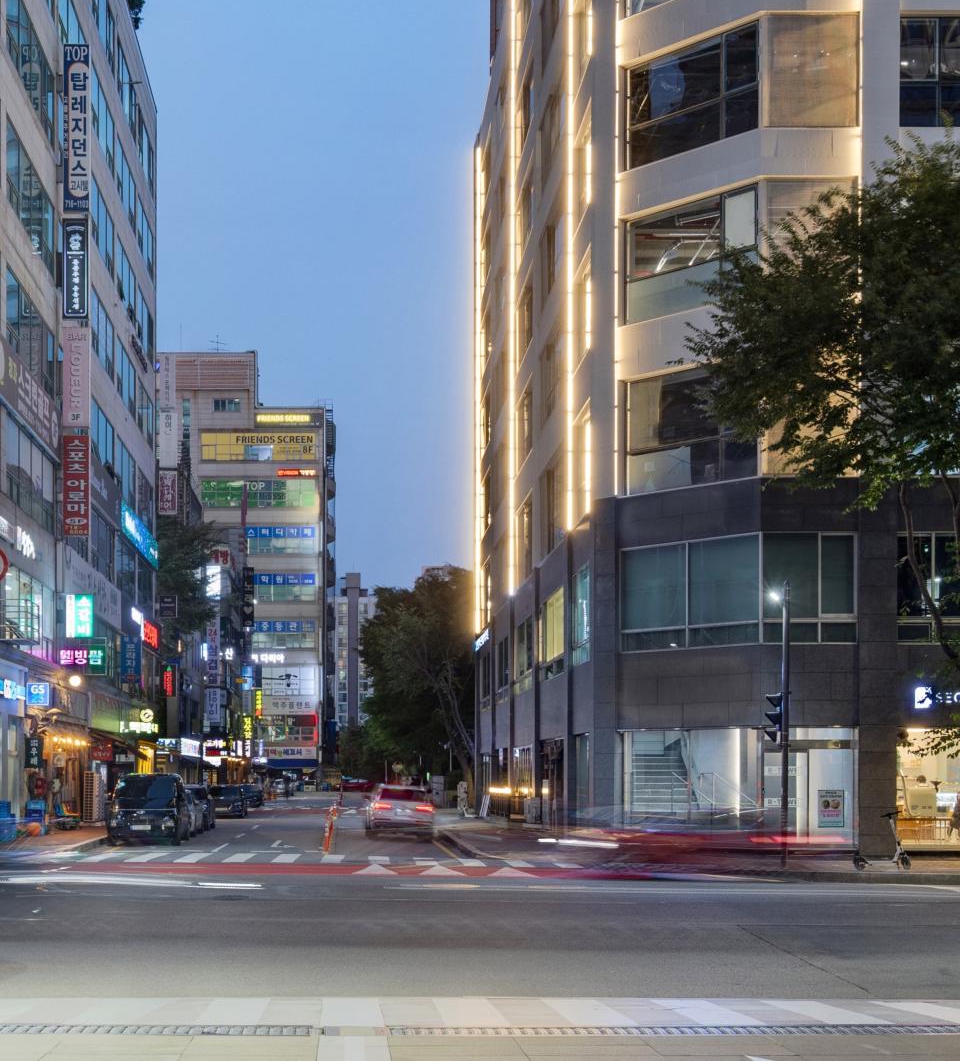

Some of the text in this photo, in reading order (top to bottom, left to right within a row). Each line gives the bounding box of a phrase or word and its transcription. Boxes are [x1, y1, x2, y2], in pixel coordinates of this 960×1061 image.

[65, 46, 88, 61] TOP
[71, 72, 88, 176] 탑레지던스
[236, 435, 313, 444] FRIENDS SCREEN
[66, 439, 88, 515] 스포츠 아로마
[247, 527, 313, 537] 스터디카페
[30, 684, 45, 694] GS
